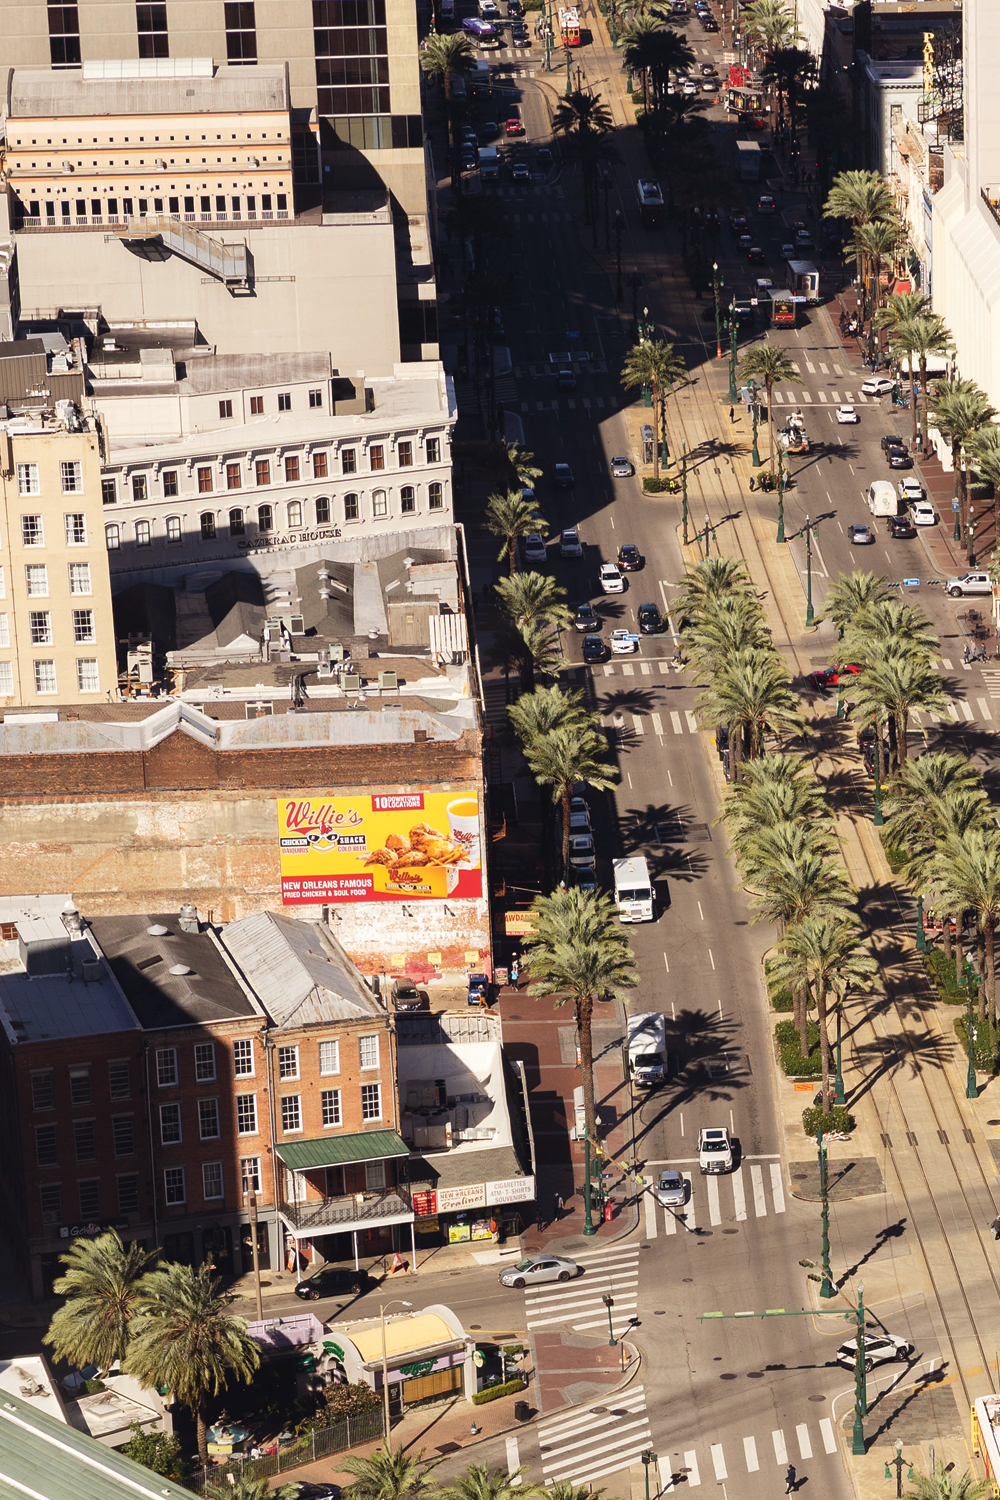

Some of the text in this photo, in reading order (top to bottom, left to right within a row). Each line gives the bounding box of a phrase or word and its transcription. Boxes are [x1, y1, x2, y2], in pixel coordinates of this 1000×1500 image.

[238, 529, 342, 549] SAZERAC HOUSE
[374, 796, 388, 809] 10
[387, 800, 421, 808] LOCATIONS
[285, 801, 363, 828] Willie's
[281, 836, 364, 846] CHICKEN SHACK
[283, 882, 300, 890] NEW
[302, 880, 338, 889] ORLEANS
[340, 879, 372, 888] FAMOUS
[494, 1180, 526, 1189] CIGARETTES
[511, 1185, 532, 1194] SHIRTS
[442, 1196, 483, 1210] Pralines
[494, 1193, 527, 1203] SOUVENIRS
